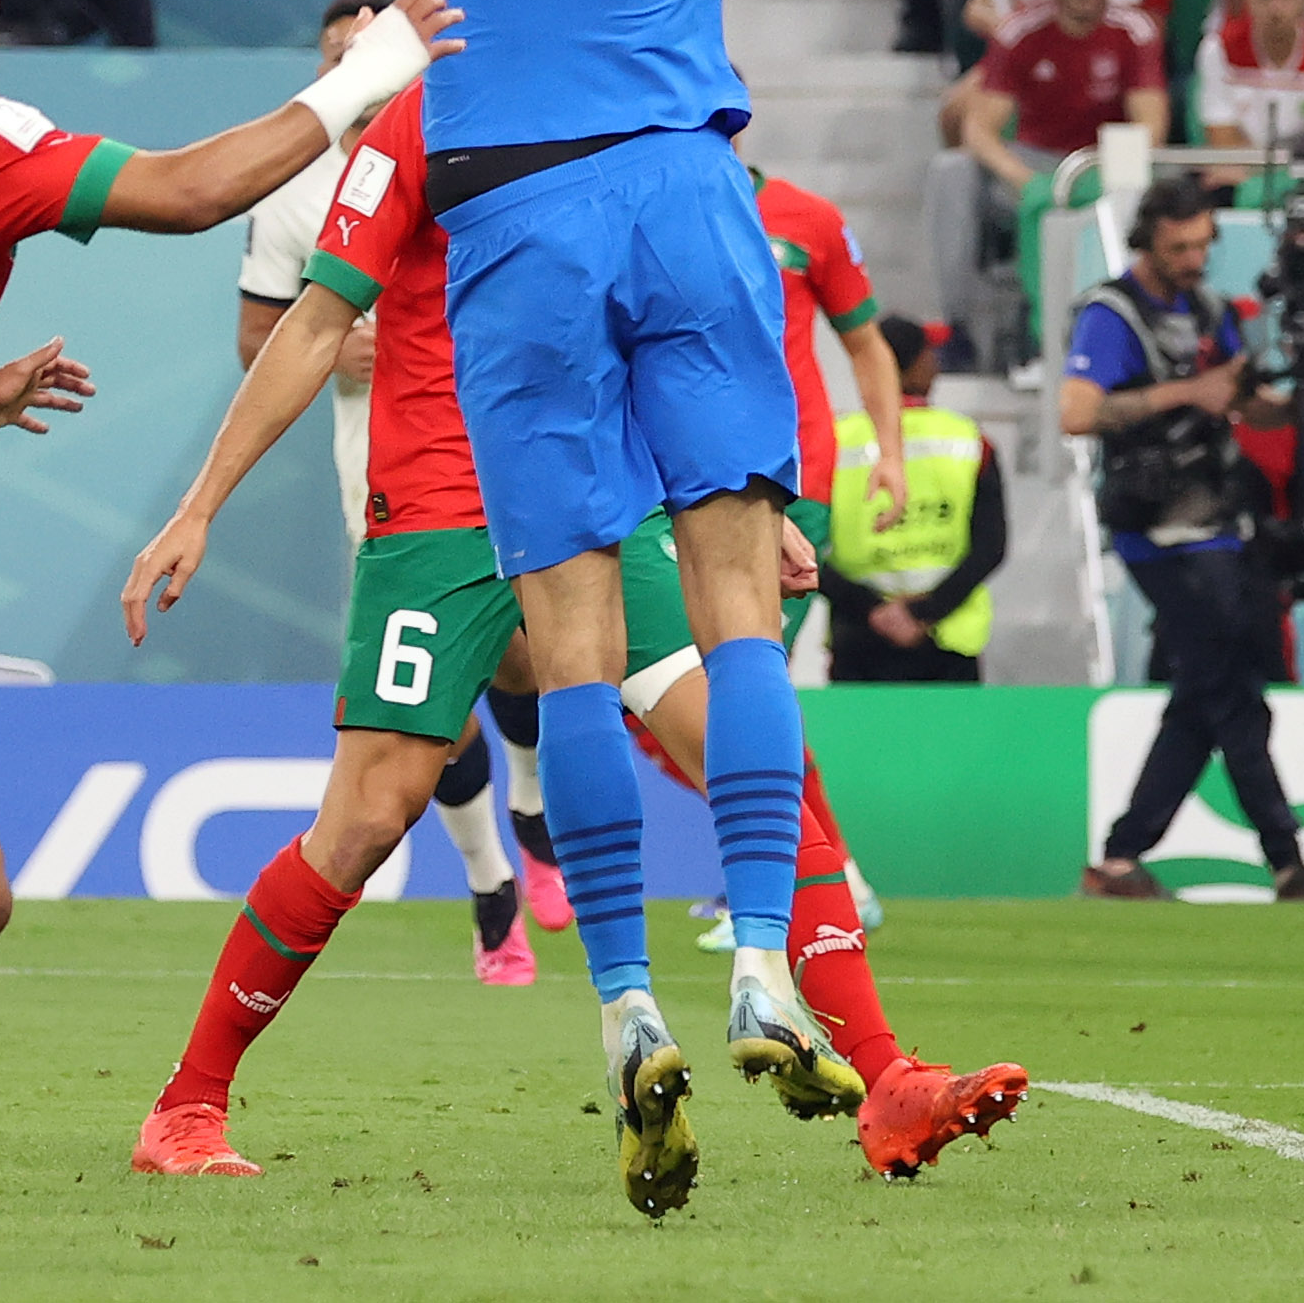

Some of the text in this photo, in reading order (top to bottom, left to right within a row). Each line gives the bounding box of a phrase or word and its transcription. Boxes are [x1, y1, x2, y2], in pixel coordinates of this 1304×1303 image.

[375, 609, 438, 706] 6
[801, 937, 855, 960] PUMA
[229, 981, 275, 1014] PUMA
